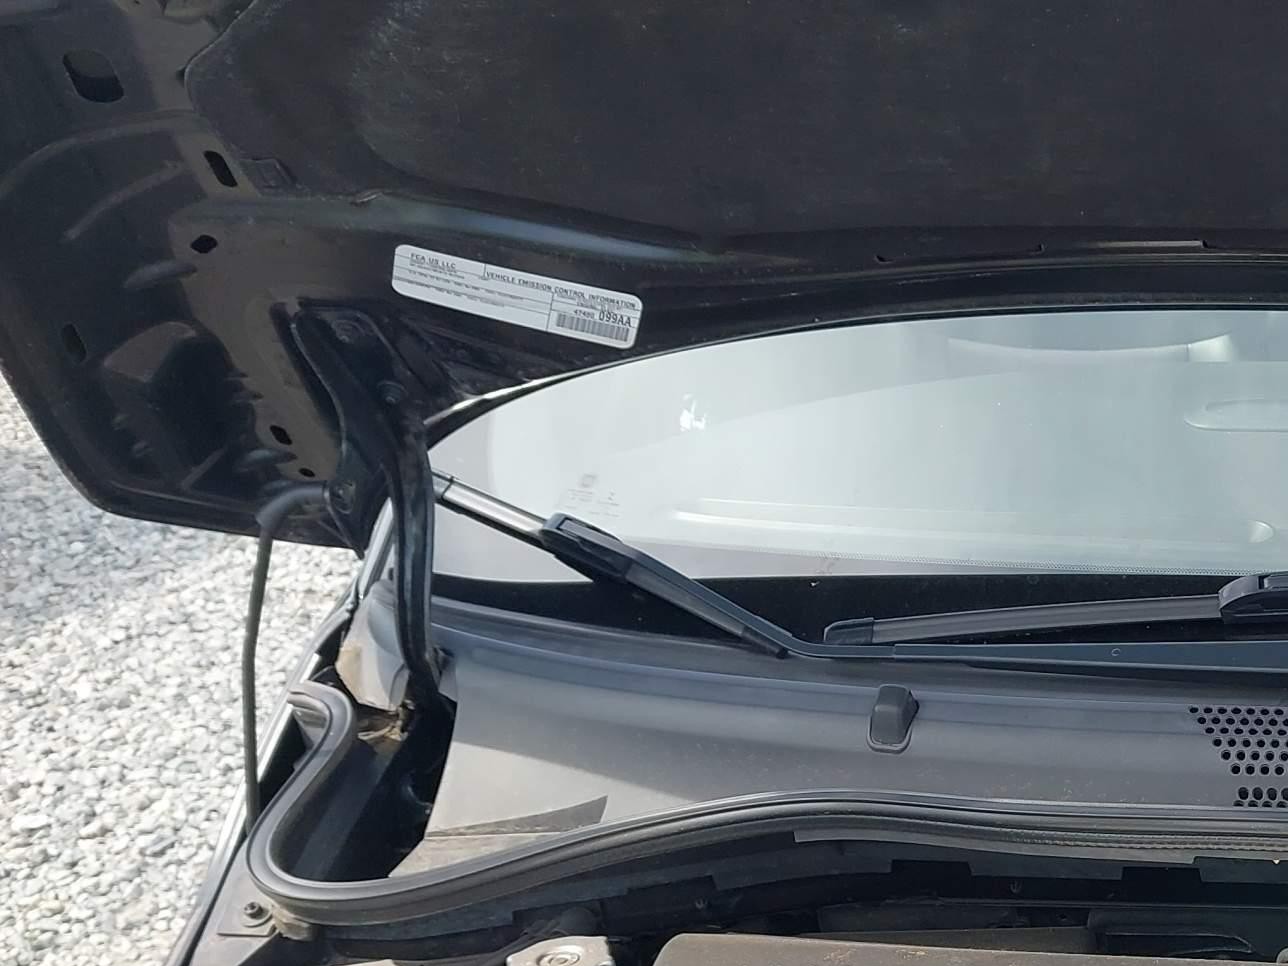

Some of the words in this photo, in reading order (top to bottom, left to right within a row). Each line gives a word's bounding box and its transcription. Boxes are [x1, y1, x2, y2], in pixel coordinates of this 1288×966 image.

[486, 271, 515, 284] VEHICLE
[518, 278, 552, 291] EMISSION
[554, 286, 586, 299] CONTROL
[588, 293, 636, 310] INFORMATION
